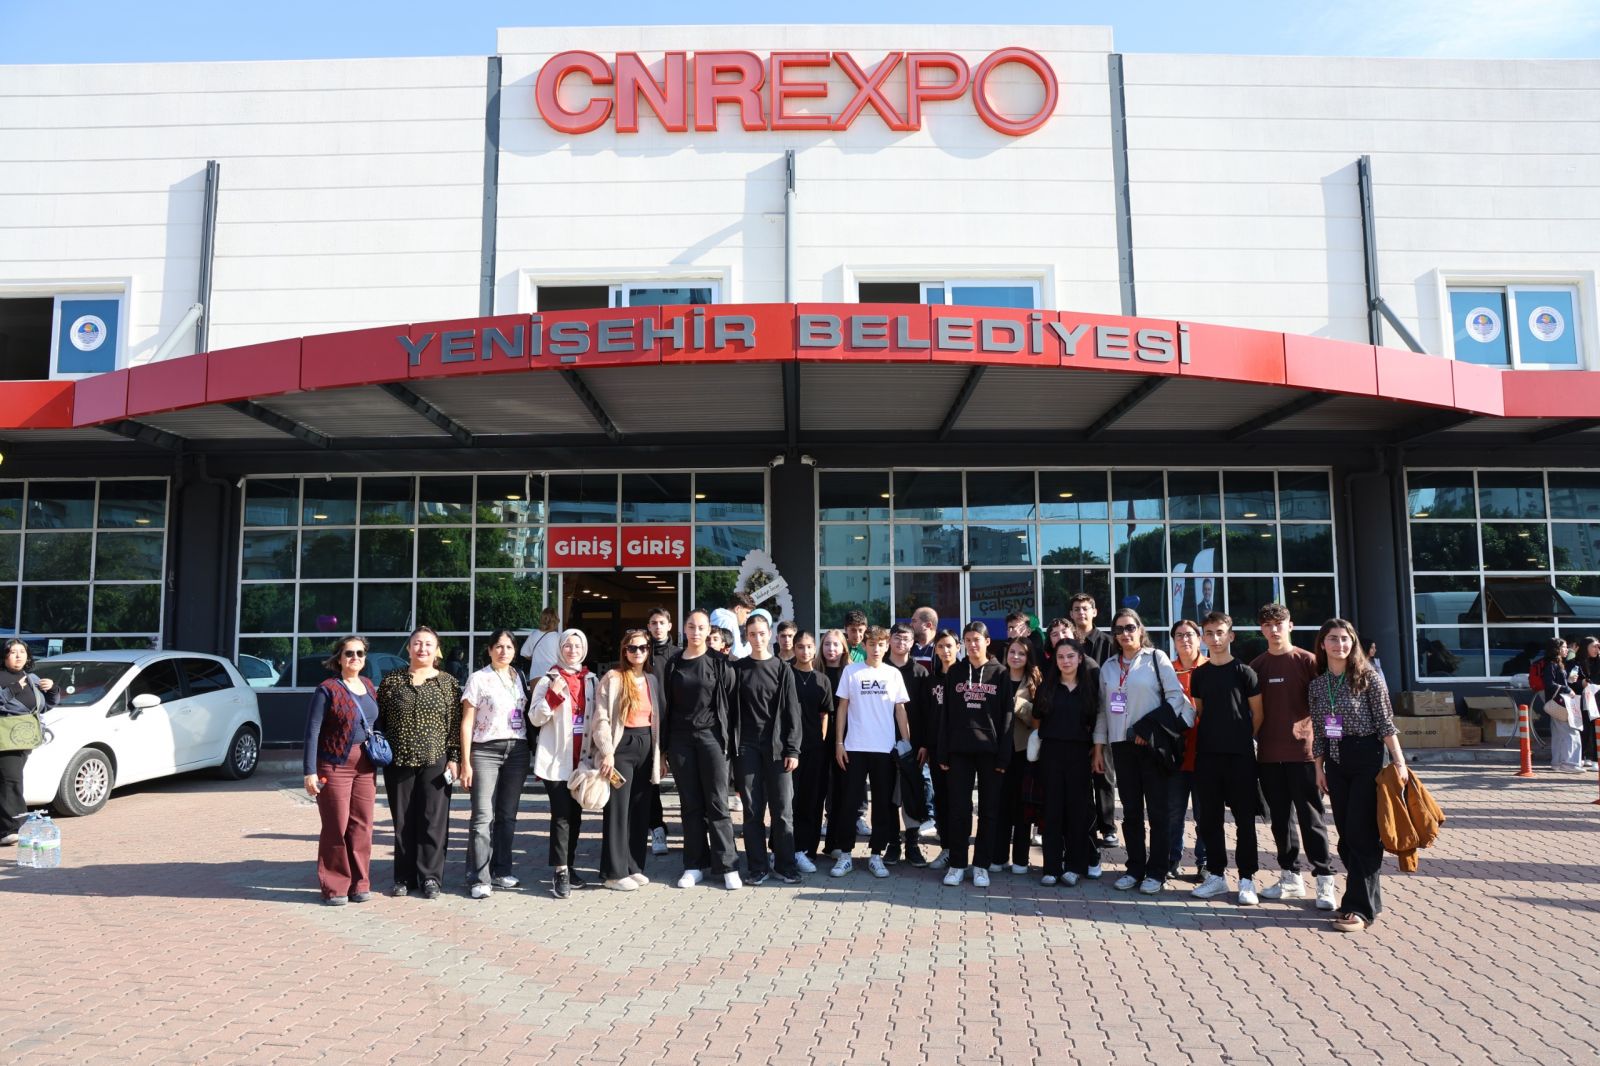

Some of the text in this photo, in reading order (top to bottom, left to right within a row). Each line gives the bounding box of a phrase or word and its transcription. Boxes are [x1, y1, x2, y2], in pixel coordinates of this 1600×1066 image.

[535, 47, 1059, 136] CNREXPO
[396, 306, 1191, 366] YENİŞEHİR BELEDİYESİ
[554, 535, 613, 560] GİRİŞ
[626, 535, 685, 559] GİRİŞ
